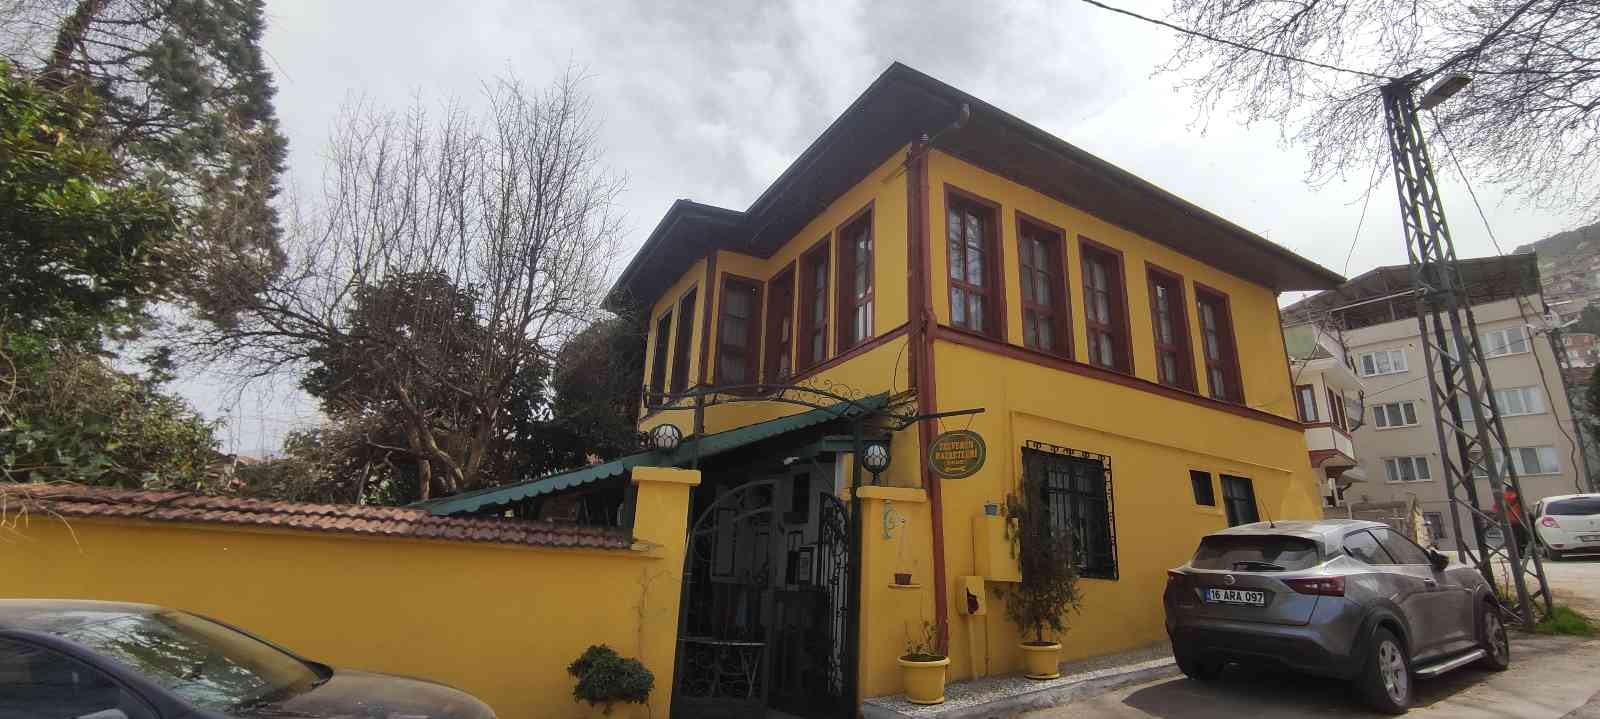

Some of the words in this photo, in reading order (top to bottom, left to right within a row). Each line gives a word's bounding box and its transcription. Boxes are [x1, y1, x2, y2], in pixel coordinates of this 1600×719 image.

[1211, 590, 1221, 600] 16
[1224, 590, 1242, 601] ARA
[1245, 591, 1263, 602] 097
